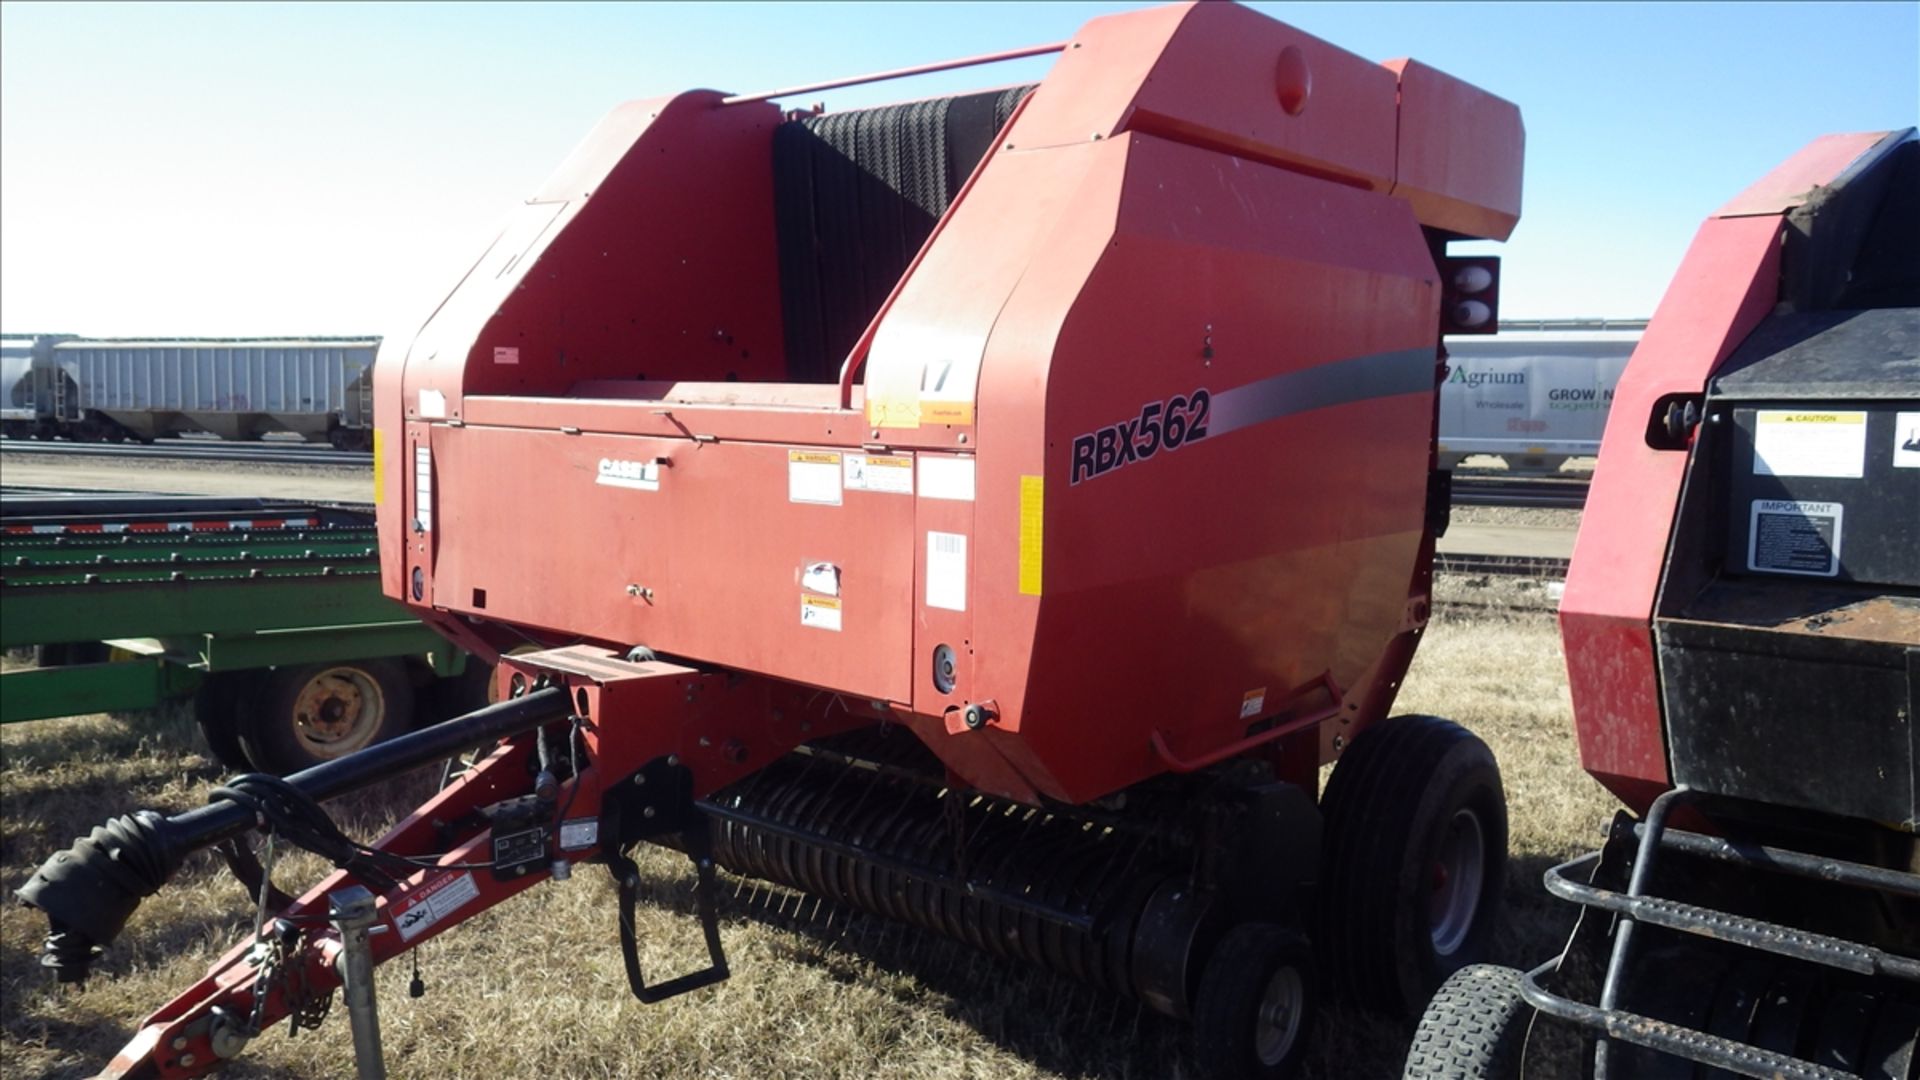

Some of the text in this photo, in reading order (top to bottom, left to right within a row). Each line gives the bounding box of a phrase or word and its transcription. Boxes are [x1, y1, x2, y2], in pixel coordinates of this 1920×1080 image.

[1450, 365, 1525, 388] Agrium
[1476, 399, 1524, 410] Wholesale
[1795, 414, 1837, 422] CAUTION
[1070, 387, 1211, 486] RBX562
[1761, 501, 1832, 513] IMPORTANT
[419, 874, 455, 899] DANGER
